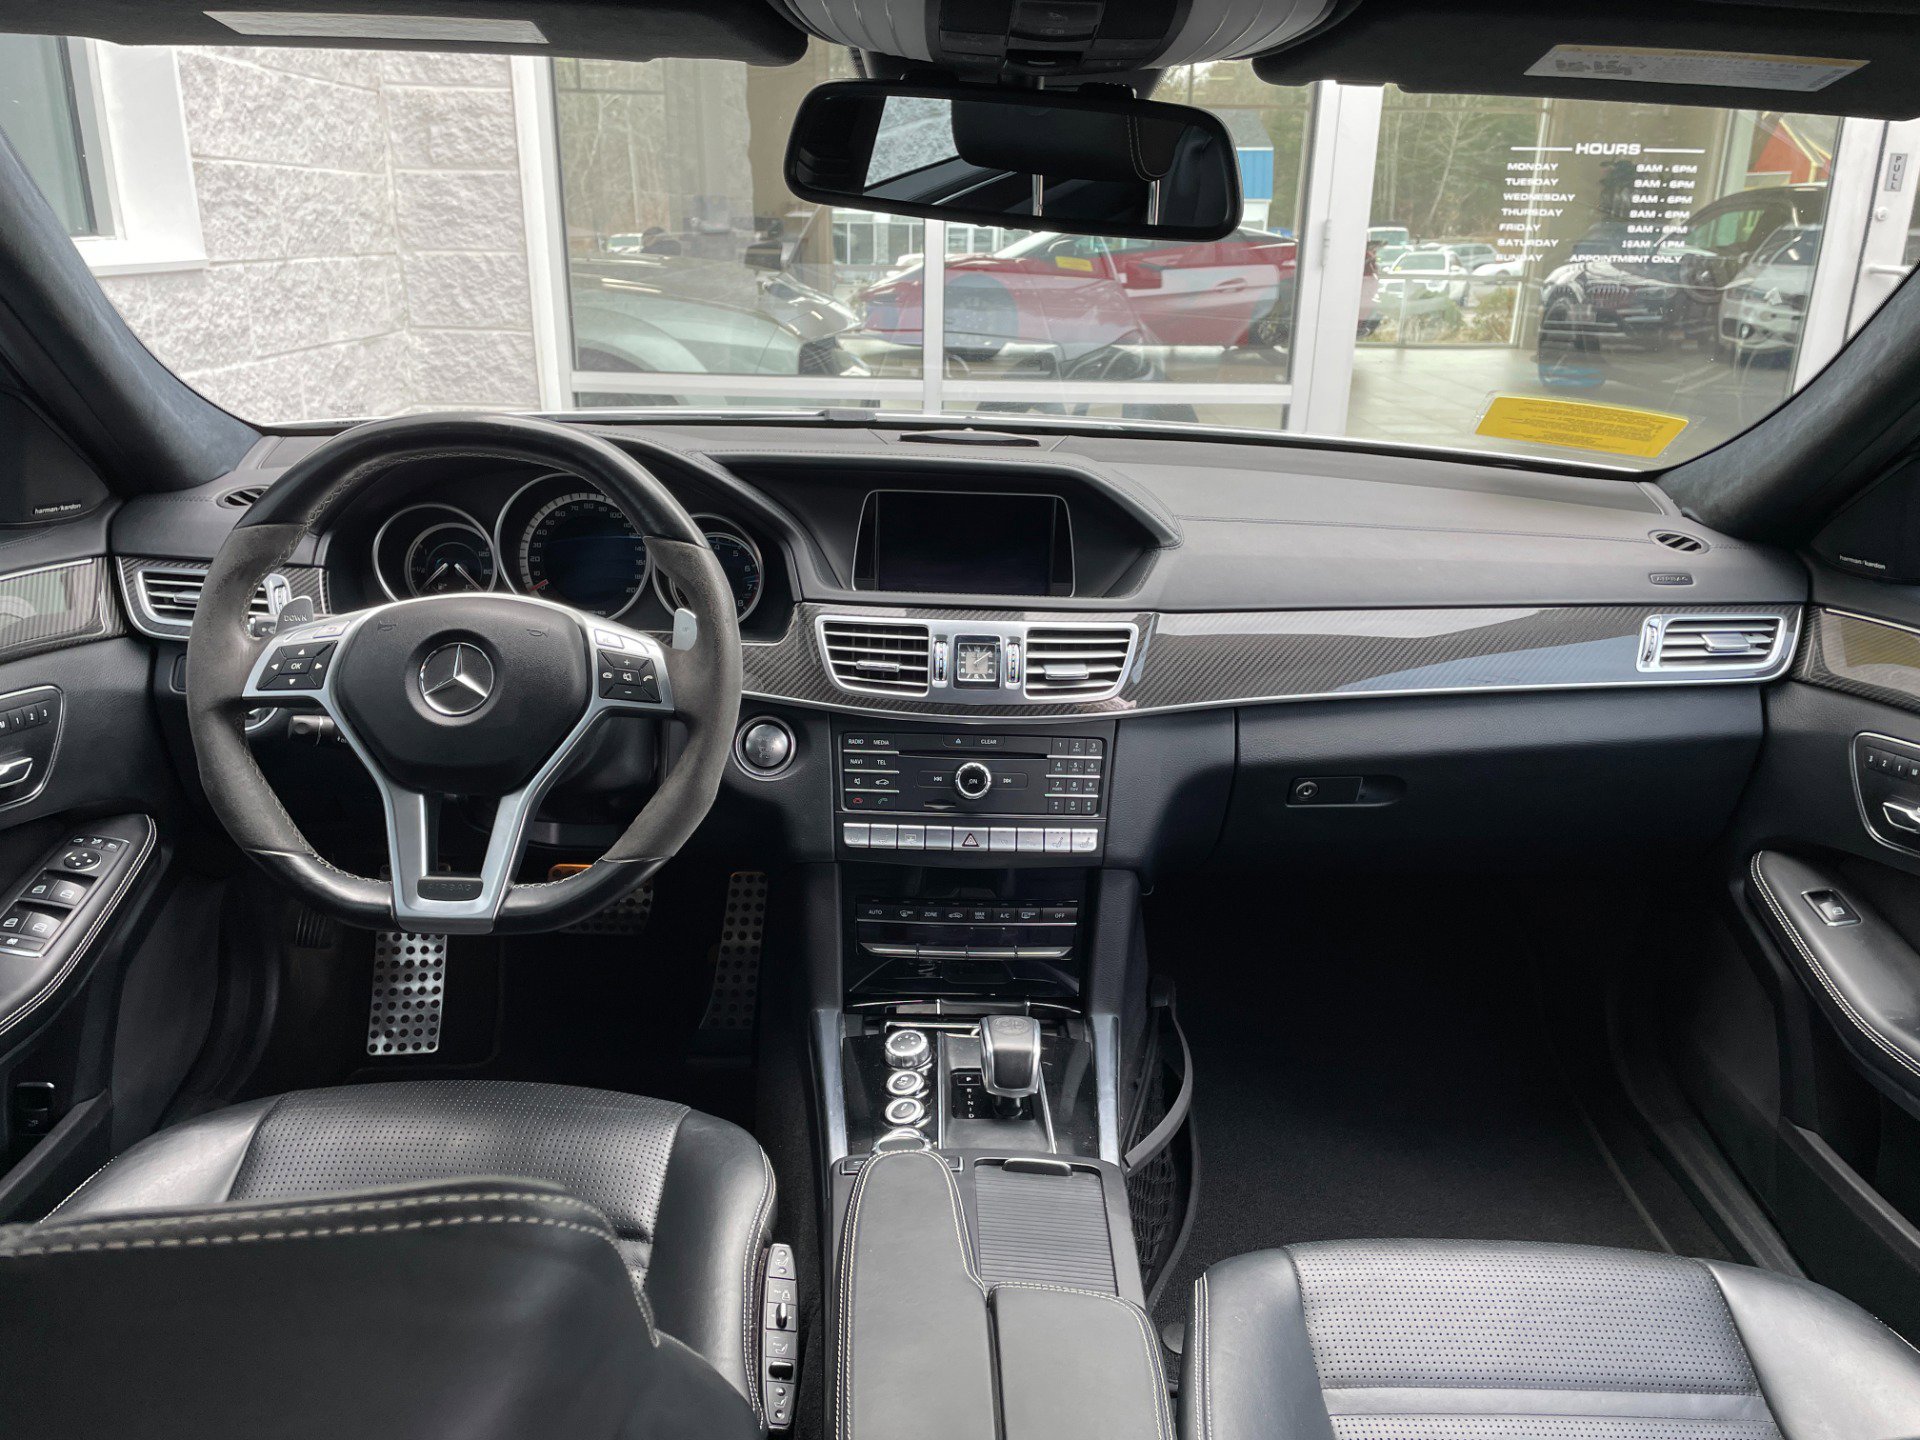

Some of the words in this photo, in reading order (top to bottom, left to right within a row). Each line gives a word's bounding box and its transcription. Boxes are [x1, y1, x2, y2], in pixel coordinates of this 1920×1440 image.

[1575, 142, 1642, 156] HOURS
[1506, 162, 1558, 171] MONDAY
[1890, 155, 1902, 190] PULL
[1505, 177, 1559, 186] TUESDAY
[1503, 193, 1576, 202] WEDNESDAY
[1501, 208, 1563, 217] THURSDAY
[1499, 223, 1541, 231] FRIDAY
[1497, 238, 1559, 247] SATURDAY
[1495, 254, 1544, 262] SUNDAY
[1569, 254, 1650, 263] APPOINTMENT
[1651, 255, 1683, 263] ONLY
